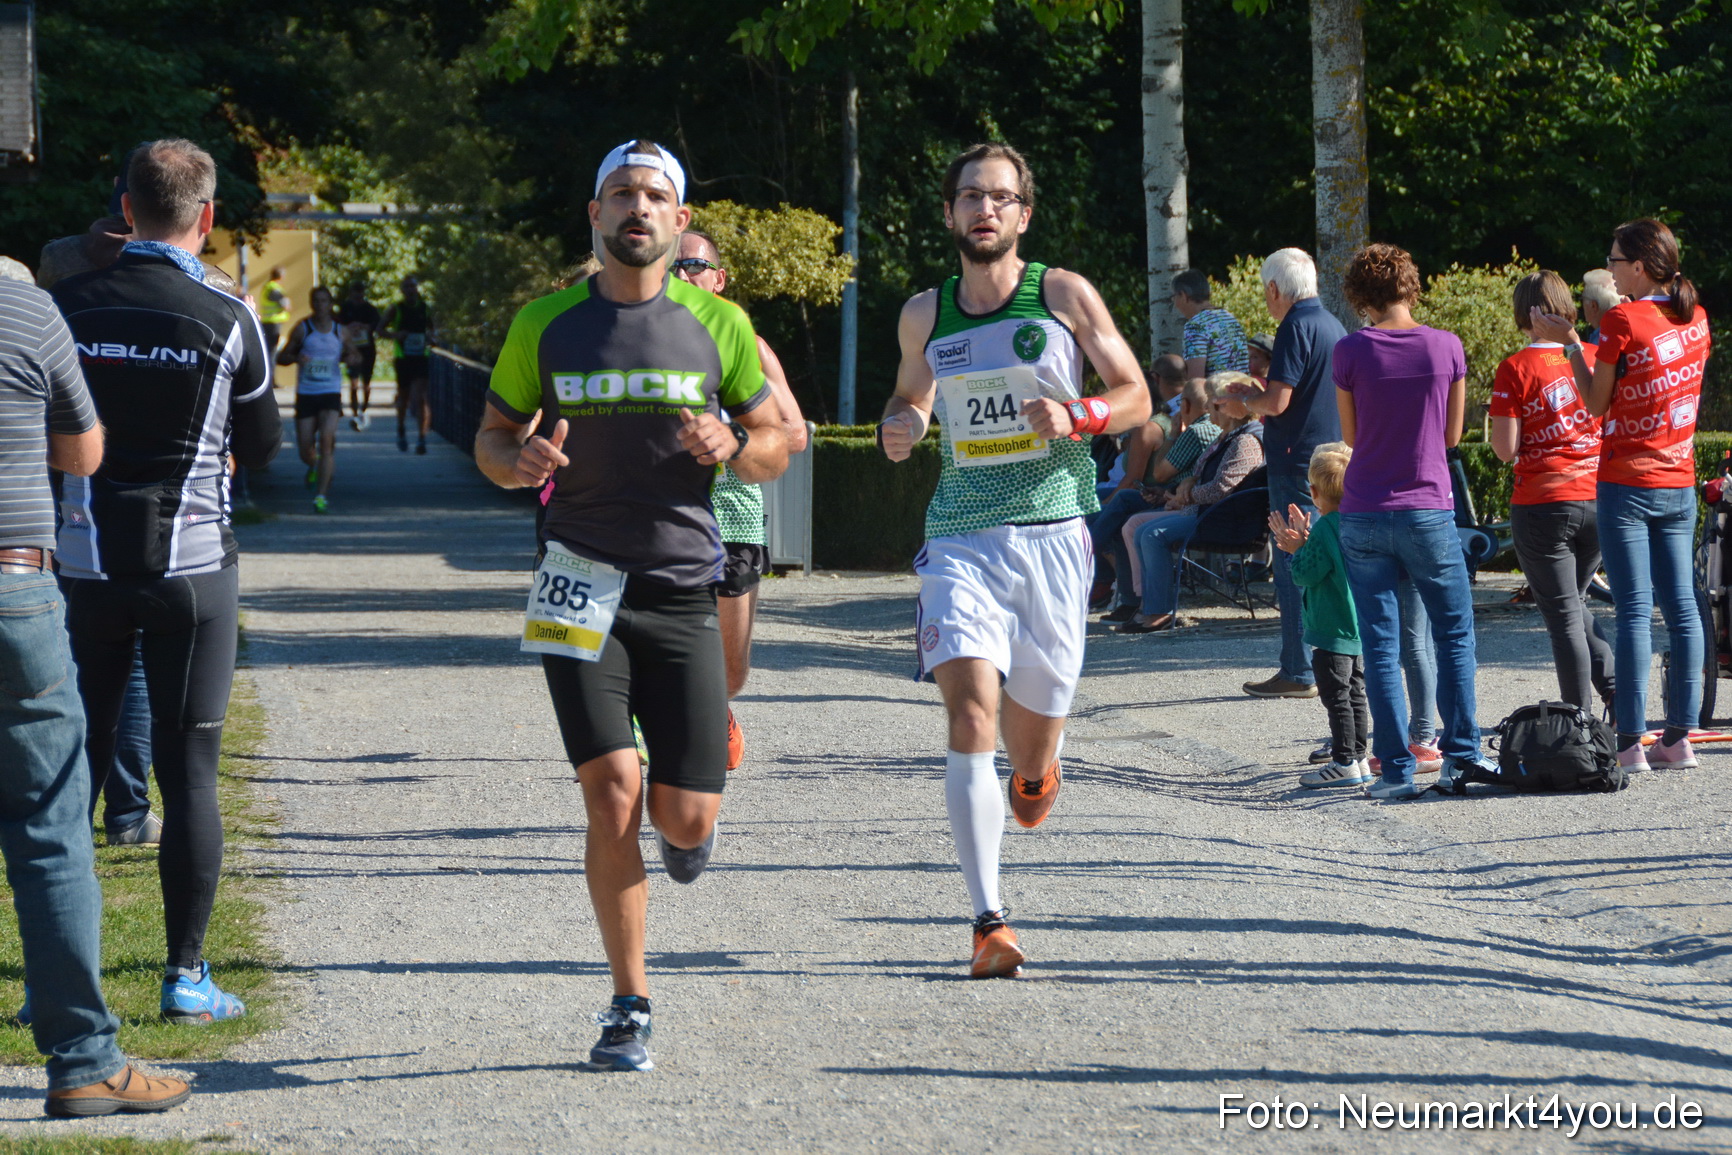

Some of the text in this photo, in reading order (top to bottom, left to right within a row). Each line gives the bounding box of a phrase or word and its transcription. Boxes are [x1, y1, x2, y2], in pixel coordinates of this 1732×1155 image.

[135, 359, 197, 371] GROUP
[1540, 353, 1570, 367] Tea
[553, 371, 704, 404] BOCK
[966, 376, 1008, 390] BOCK
[598, 404, 614, 416] by
[617, 403, 654, 414] smart
[967, 393, 1018, 426] 244
[988, 427, 1016, 435] Neumarkt
[968, 438, 1032, 455] Christopher
[546, 550, 594, 575] BOCK
[537, 571, 593, 612] 285
[535, 624, 568, 641] Daniel
